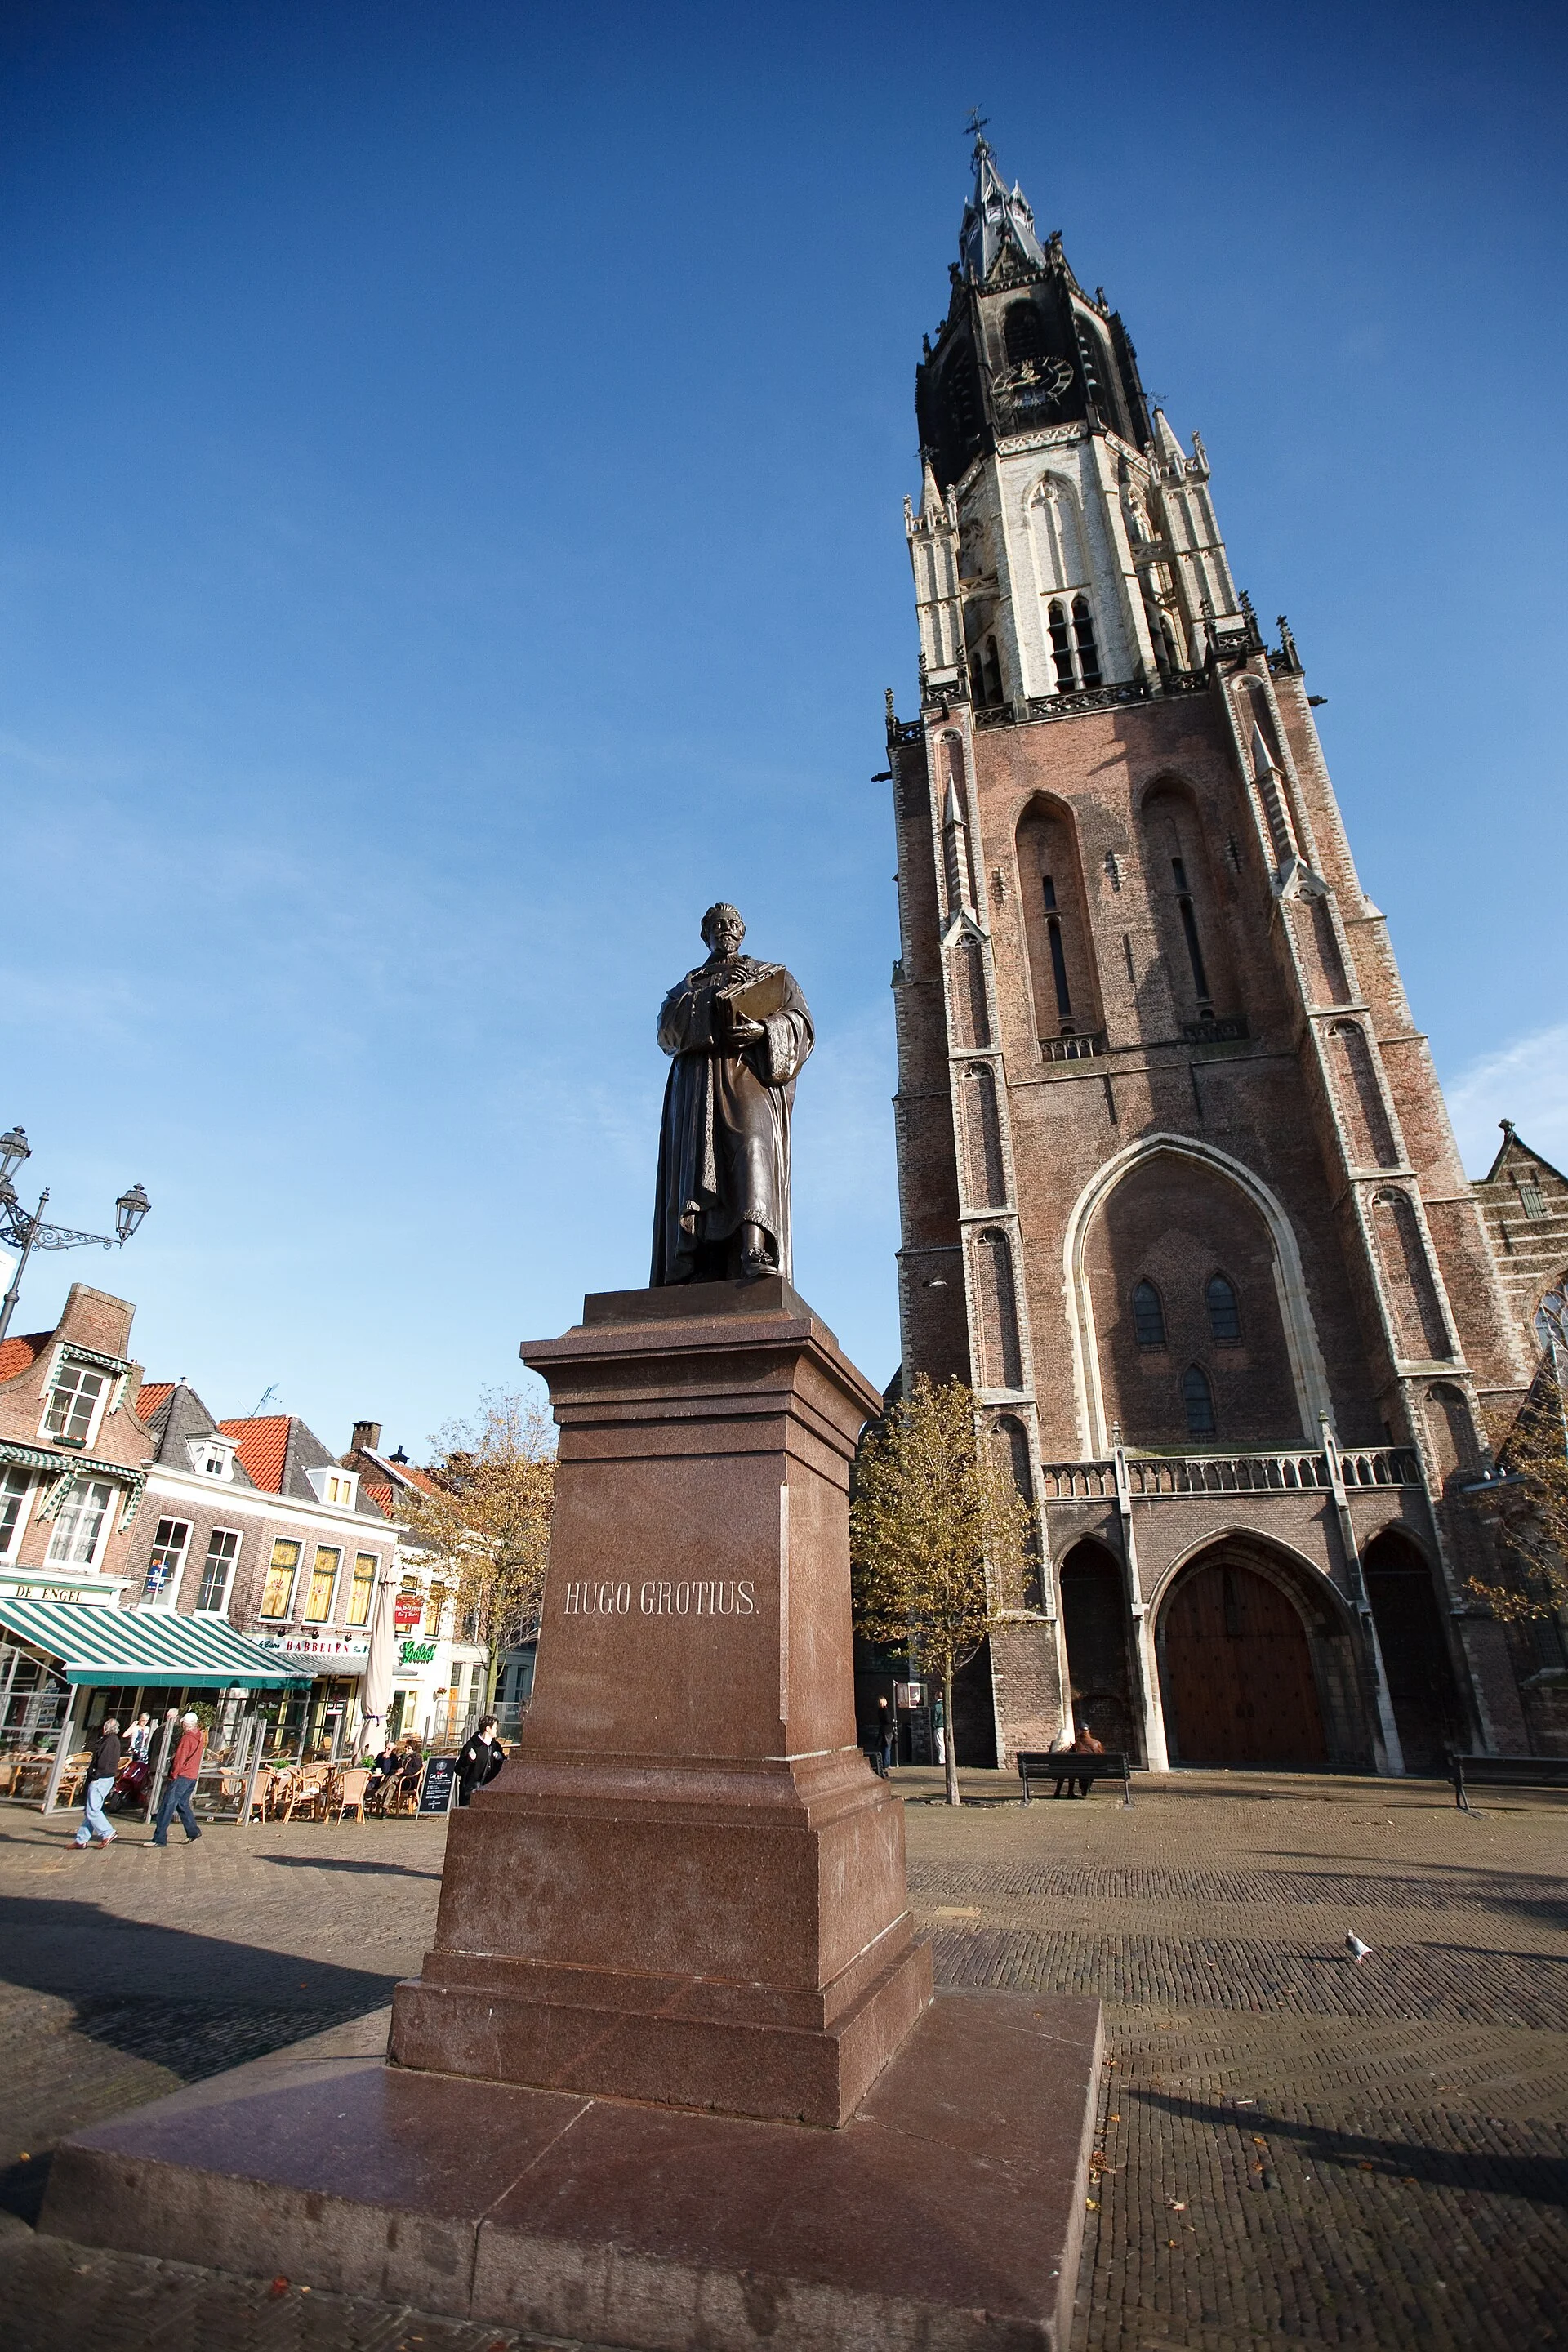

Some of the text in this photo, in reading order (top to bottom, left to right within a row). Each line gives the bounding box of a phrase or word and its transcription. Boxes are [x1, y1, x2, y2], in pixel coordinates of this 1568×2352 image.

[16, 1585, 82, 1602] DE ENGEL
[564, 1580, 760, 1615] HUGO GROTIUS.
[286, 1641, 349, 1653] BABBELEN
[399, 1641, 437, 1664] Grolsch
